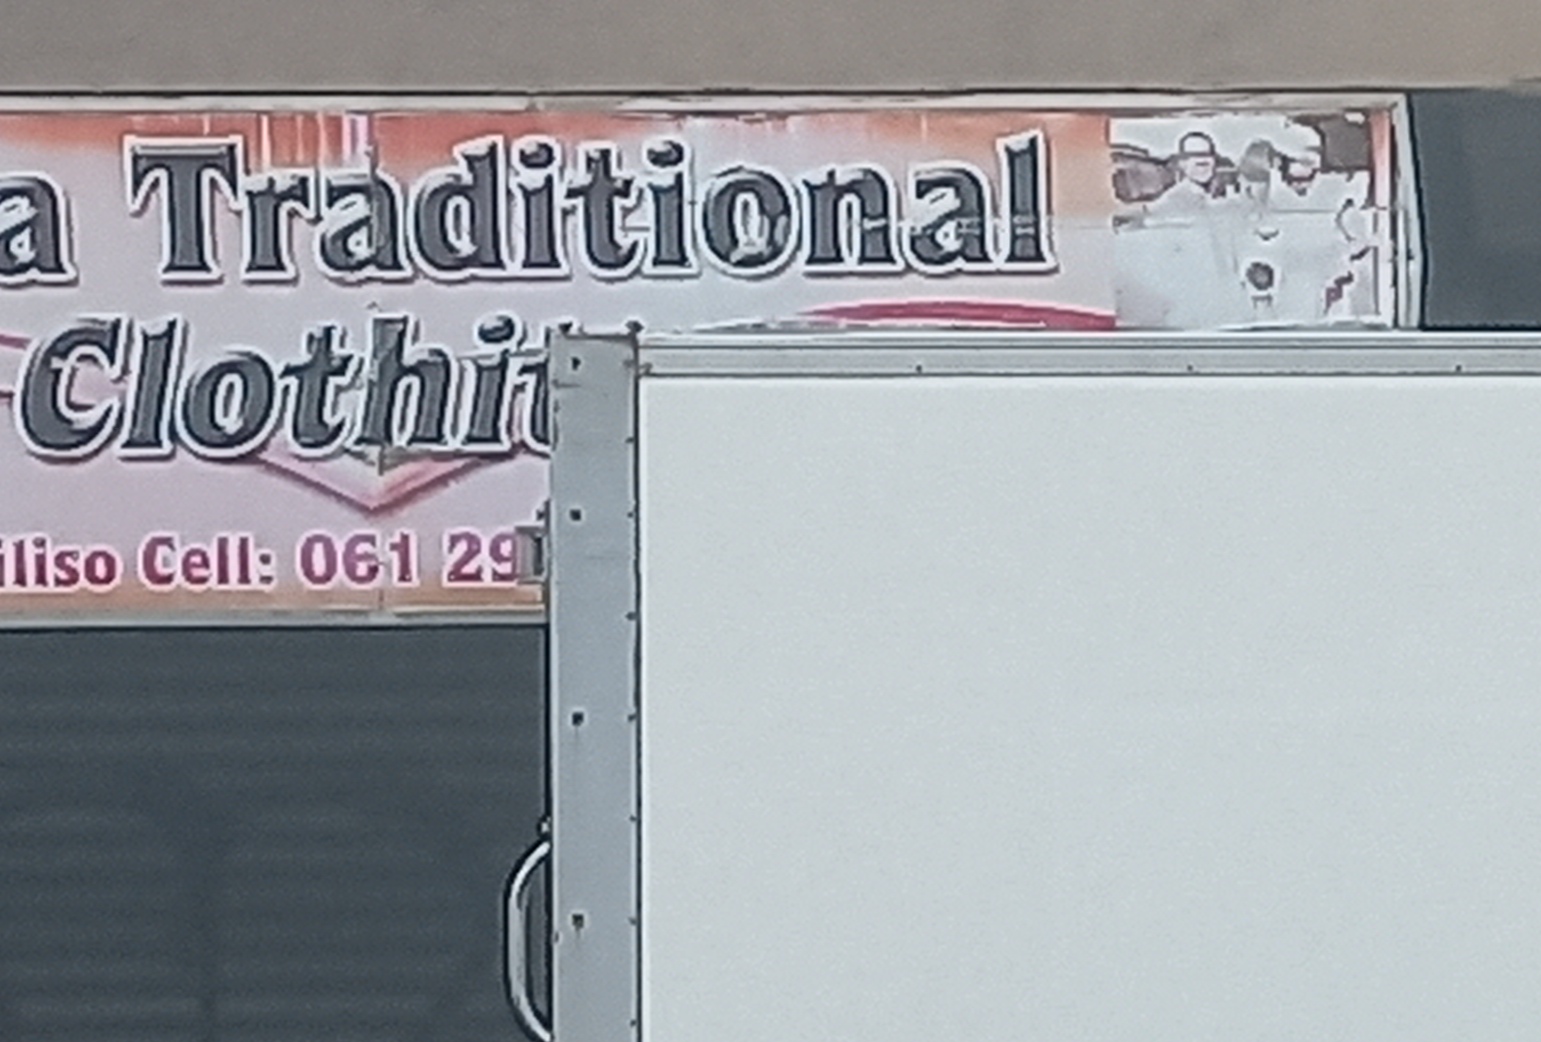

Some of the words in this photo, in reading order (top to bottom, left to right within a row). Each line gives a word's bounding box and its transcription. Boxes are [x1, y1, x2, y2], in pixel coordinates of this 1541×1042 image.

[127, 133, 1055, 281] Traditional
[143, 535, 273, 586] Cell:
[300, 532, 415, 585] 061
